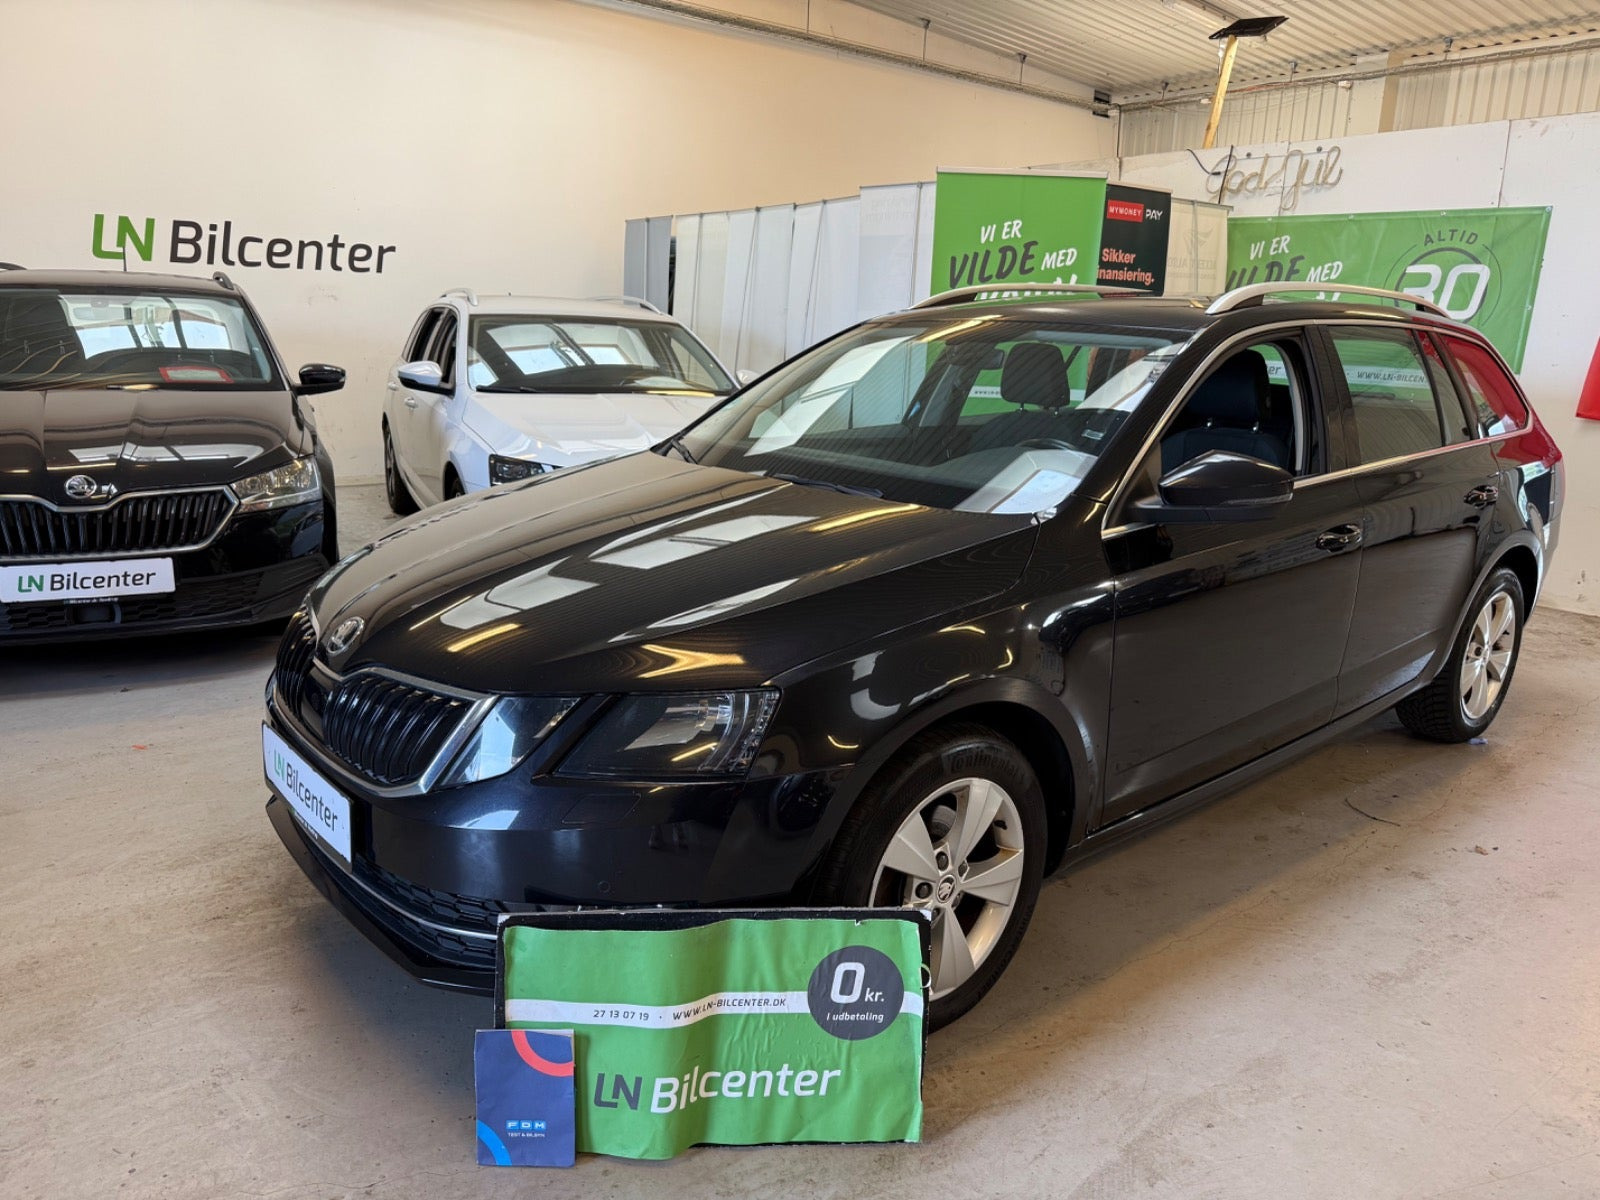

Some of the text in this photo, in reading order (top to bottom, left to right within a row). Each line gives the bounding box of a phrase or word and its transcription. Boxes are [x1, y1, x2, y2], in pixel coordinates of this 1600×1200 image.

[1109, 206, 1163, 220] MYMONEY PAY
[980, 220, 1023, 244] VI ER
[1423, 229, 1478, 246] ALTID
[92, 213, 397, 274] LN Bilcenter
[1250, 235, 1291, 260] VI ER
[950, 240, 1039, 290] VILDE
[1041, 248, 1078, 271] MED
[1102, 248, 1136, 264] Sikker
[1096, 265, 1154, 286] inansiering.
[1305, 261, 1343, 283] MED
[1357, 371, 1425, 383] WWW.LN-BILCEN
[18, 571, 156, 593] LN Bilcenter
[274, 749, 285, 781] LN
[286, 761, 338, 832] Bilcenter
[830, 962, 885, 1005] 0 kr.
[593, 998, 787, 1021] 27 13 07 19 WWW.LN-BILCENTER.DK
[834, 1012, 885, 1023] udbetaling
[593, 1064, 841, 1114] LN Bilcenter
